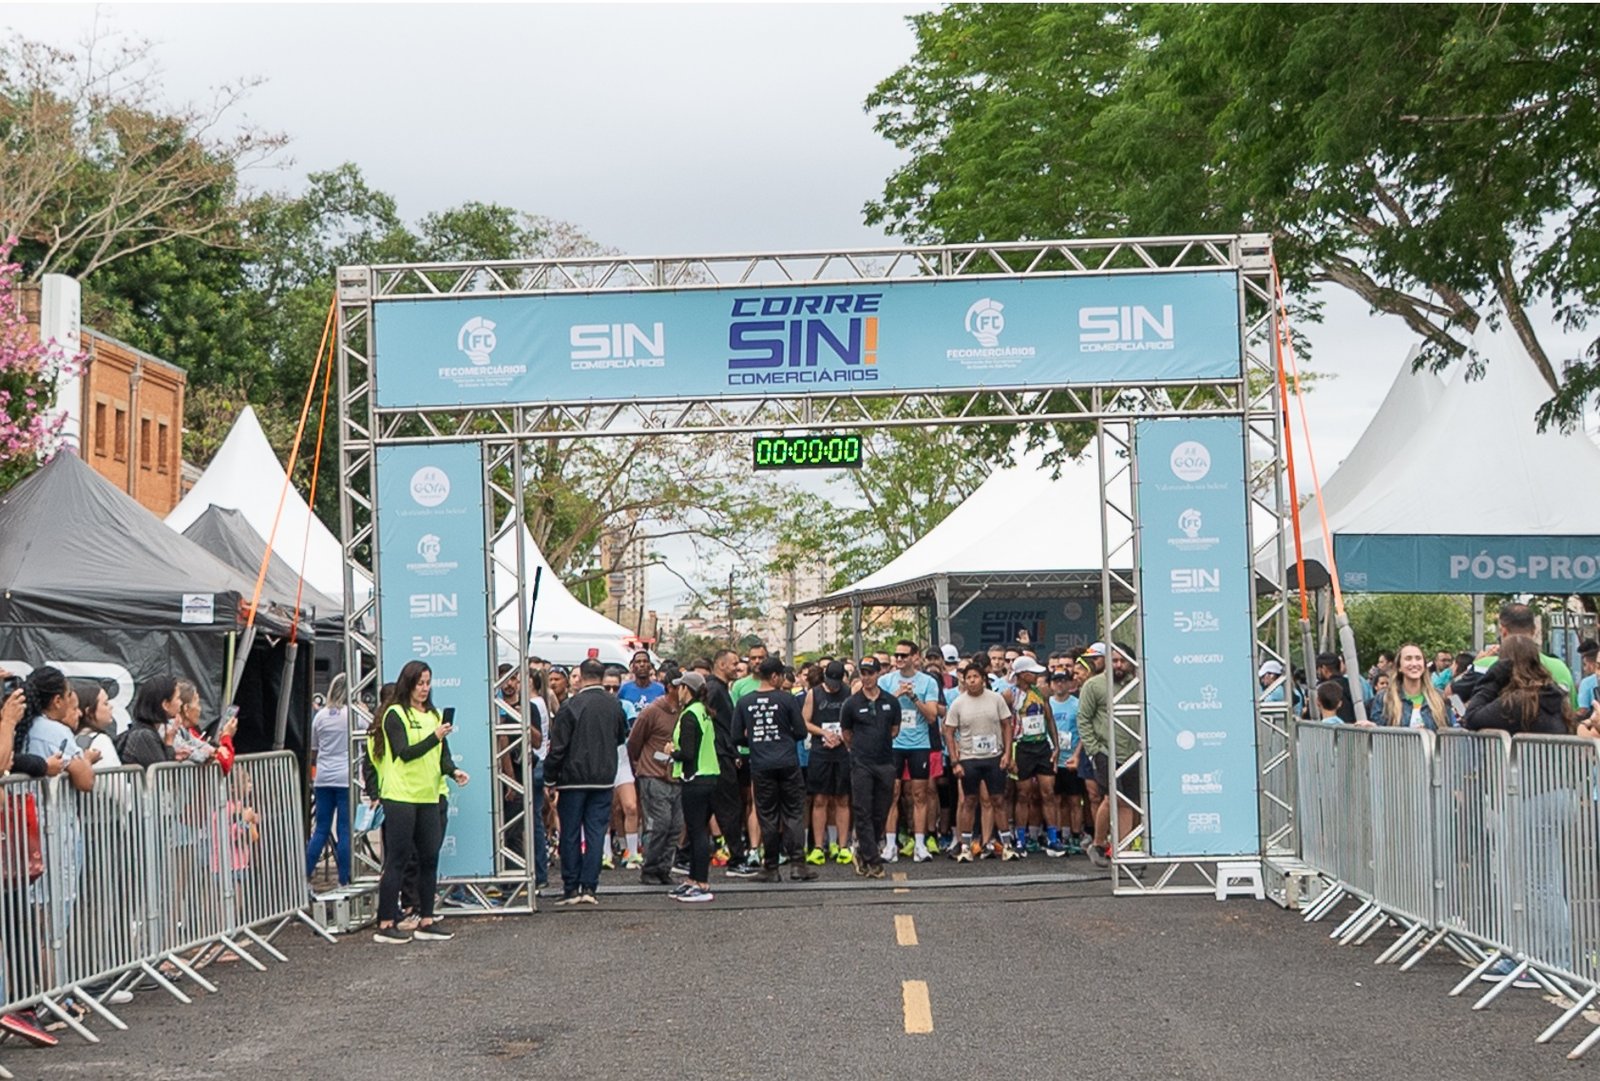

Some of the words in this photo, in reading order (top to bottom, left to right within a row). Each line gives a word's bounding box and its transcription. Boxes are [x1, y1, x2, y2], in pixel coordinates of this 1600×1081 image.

[731, 293, 883, 317] CORRE
[1079, 304, 1174, 342] SIN
[570, 322, 664, 359] SIN
[728, 317, 878, 369] SIN!
[946, 346, 1036, 359] FECOMERCIÁRIOS
[438, 364, 527, 377] FECOMERCIÁRIOS
[728, 368, 878, 385] COMERCIÁRIOS
[757, 438, 858, 464] 00:00:00
[1450, 550, 1600, 580] PÓS-PRO
[1171, 568, 1219, 588] SIN
[409, 593, 457, 613] SIN
[1055, 633, 1088, 646] SIN
